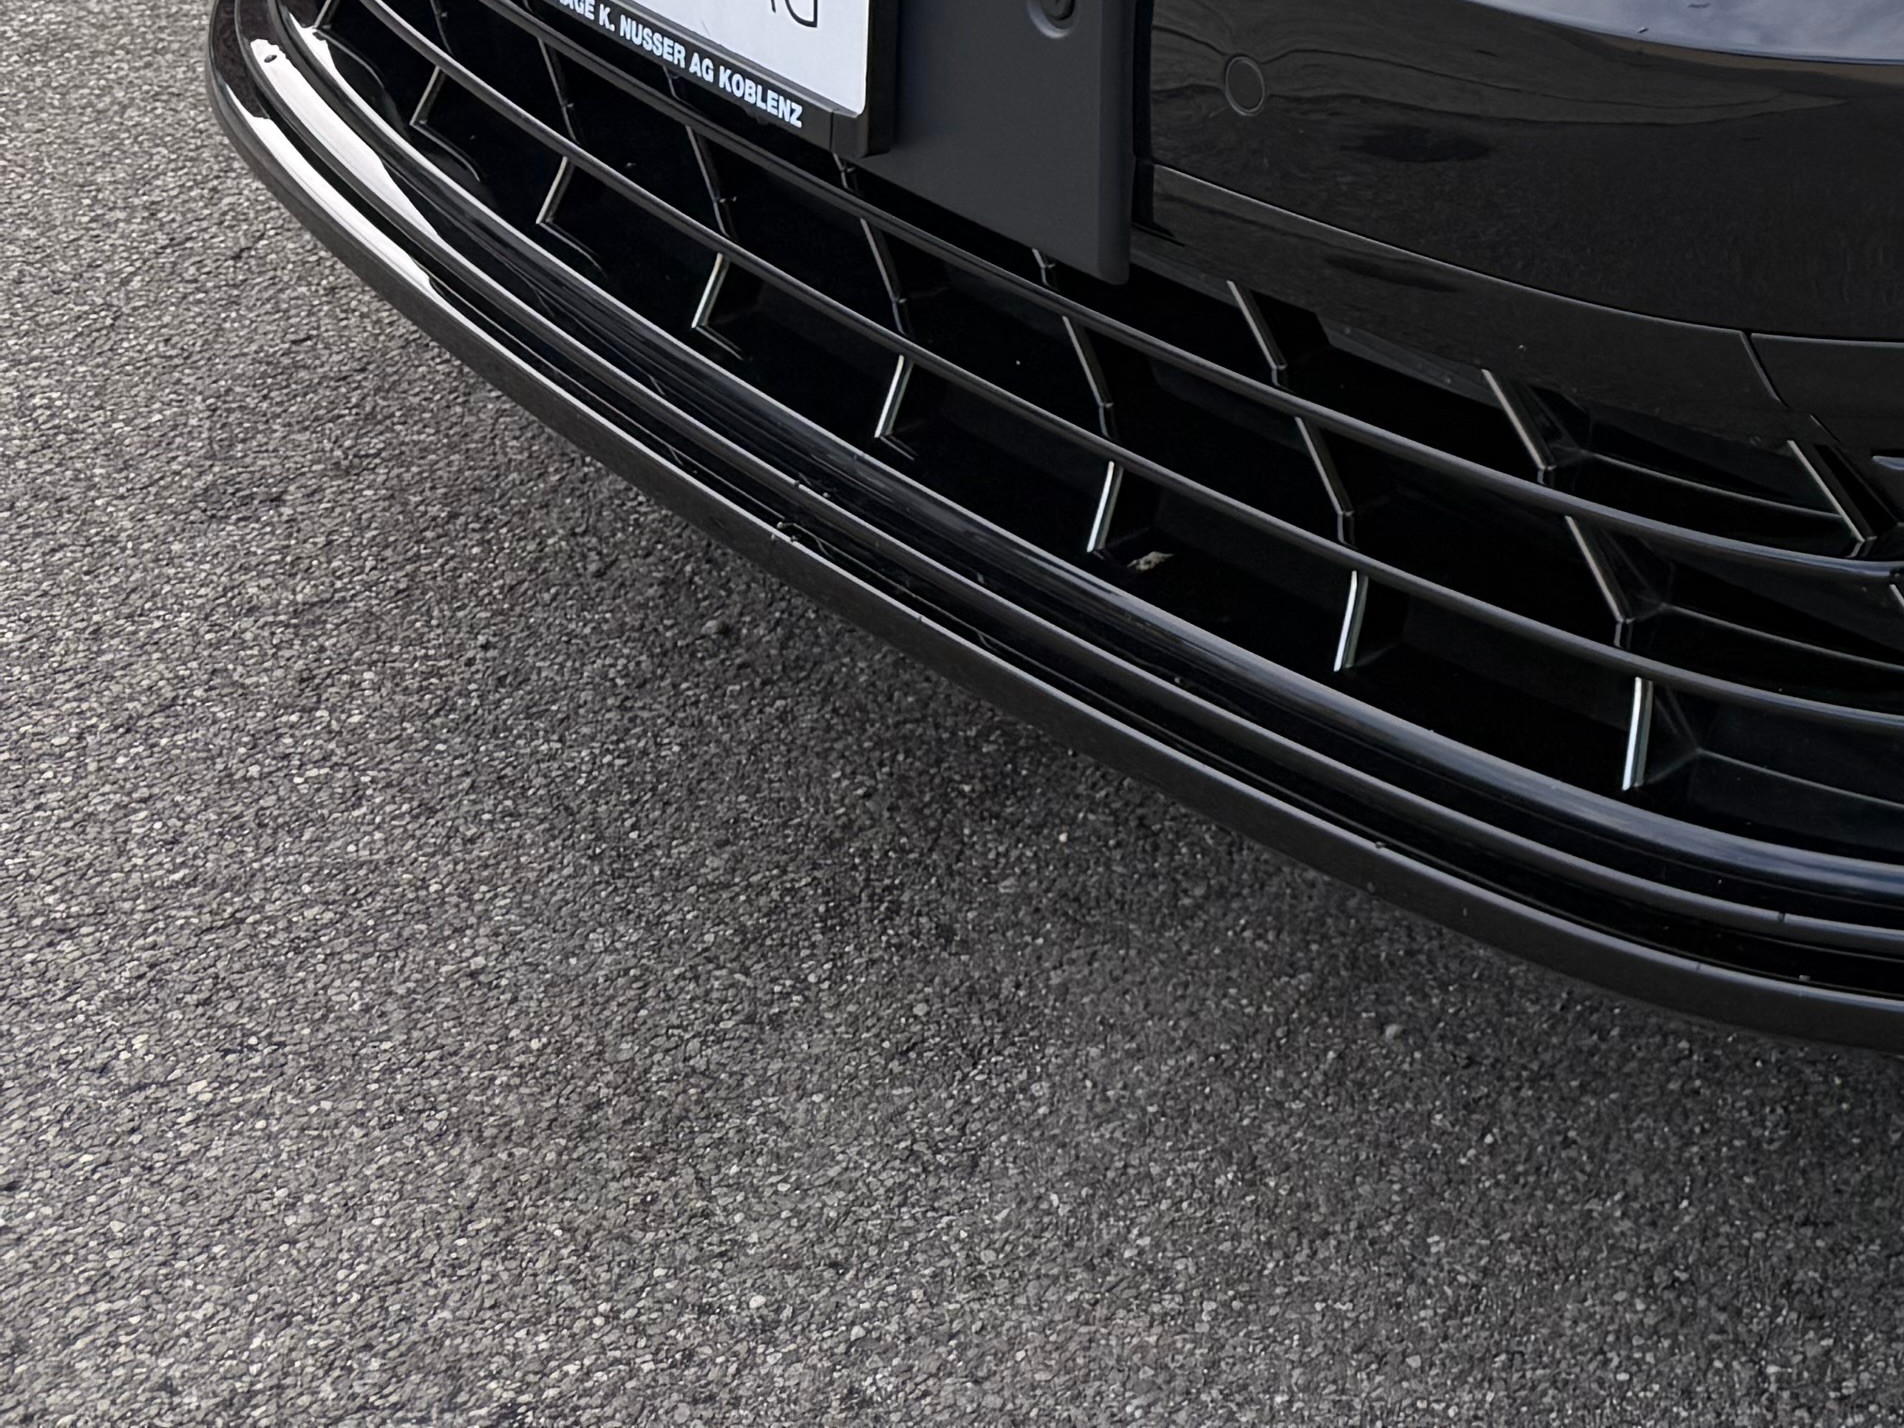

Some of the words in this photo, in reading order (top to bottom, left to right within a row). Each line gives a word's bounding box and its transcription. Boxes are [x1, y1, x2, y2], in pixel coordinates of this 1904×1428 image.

[599, 3, 616, 32] K.
[619, 14, 686, 69] NUSSER
[689, 52, 714, 84] AG
[718, 65, 804, 129] KOBLENZ
